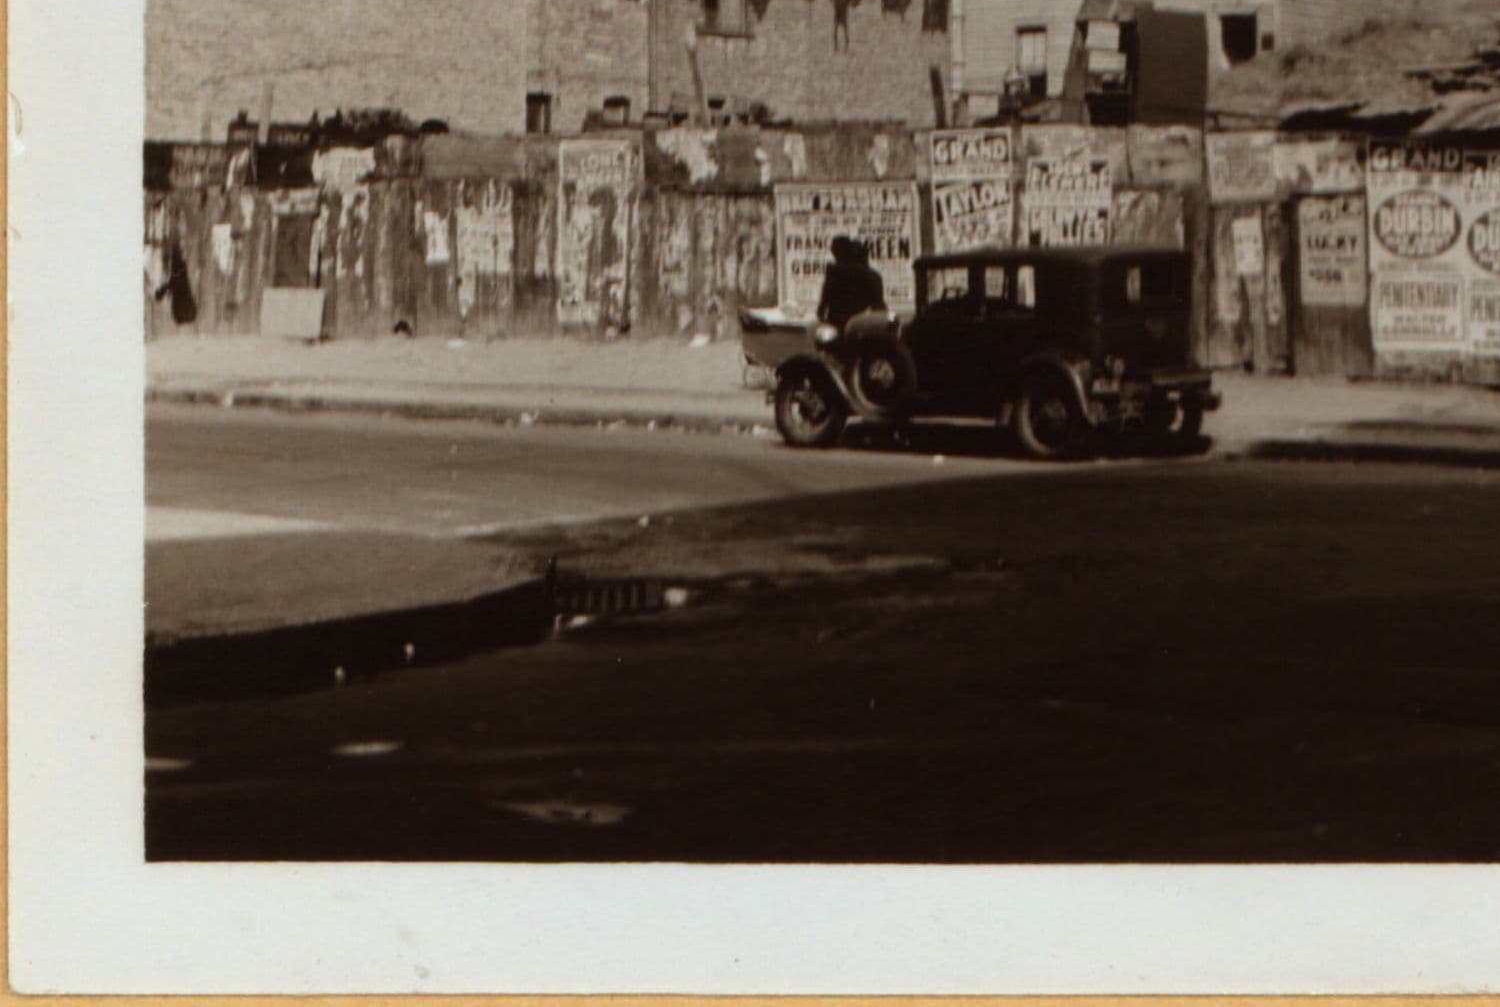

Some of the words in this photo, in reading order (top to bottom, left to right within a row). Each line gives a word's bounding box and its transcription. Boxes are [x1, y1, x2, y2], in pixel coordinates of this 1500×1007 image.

[935, 137, 1007, 164] GRAND
[1371, 146, 1460, 171] GRAND
[936, 181, 1009, 222] TAYLOR
[1379, 204, 1456, 235] DURBIN
[1379, 280, 1459, 308] PENITENTIARY
